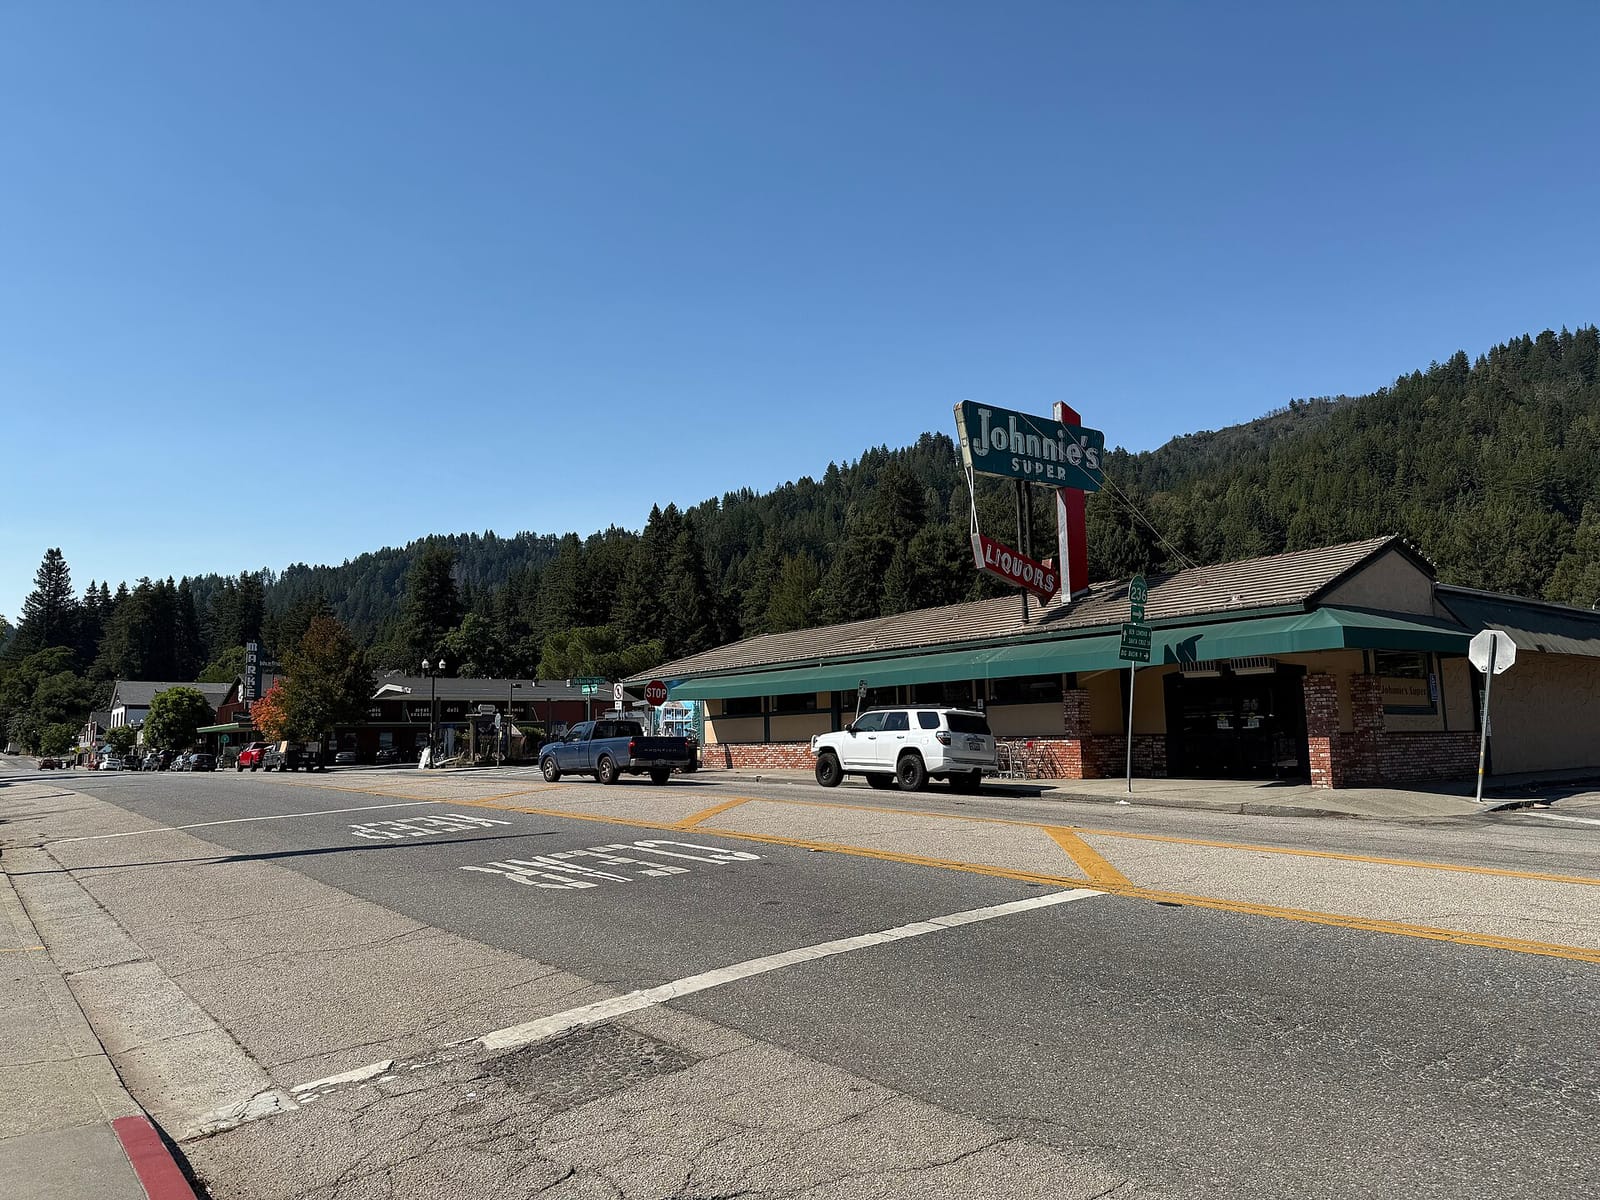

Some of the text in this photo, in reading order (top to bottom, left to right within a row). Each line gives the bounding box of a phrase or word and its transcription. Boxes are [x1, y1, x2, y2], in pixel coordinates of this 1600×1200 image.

[972, 407, 1100, 470] Johnnie's
[1011, 457, 1067, 481] SUPER
[984, 543, 1055, 593] LIQUORS
[1130, 587, 1147, 602] 236
[646, 687, 667, 699] STOP
[349, 813, 512, 839] KEEP
[458, 839, 762, 890] CLEAR
